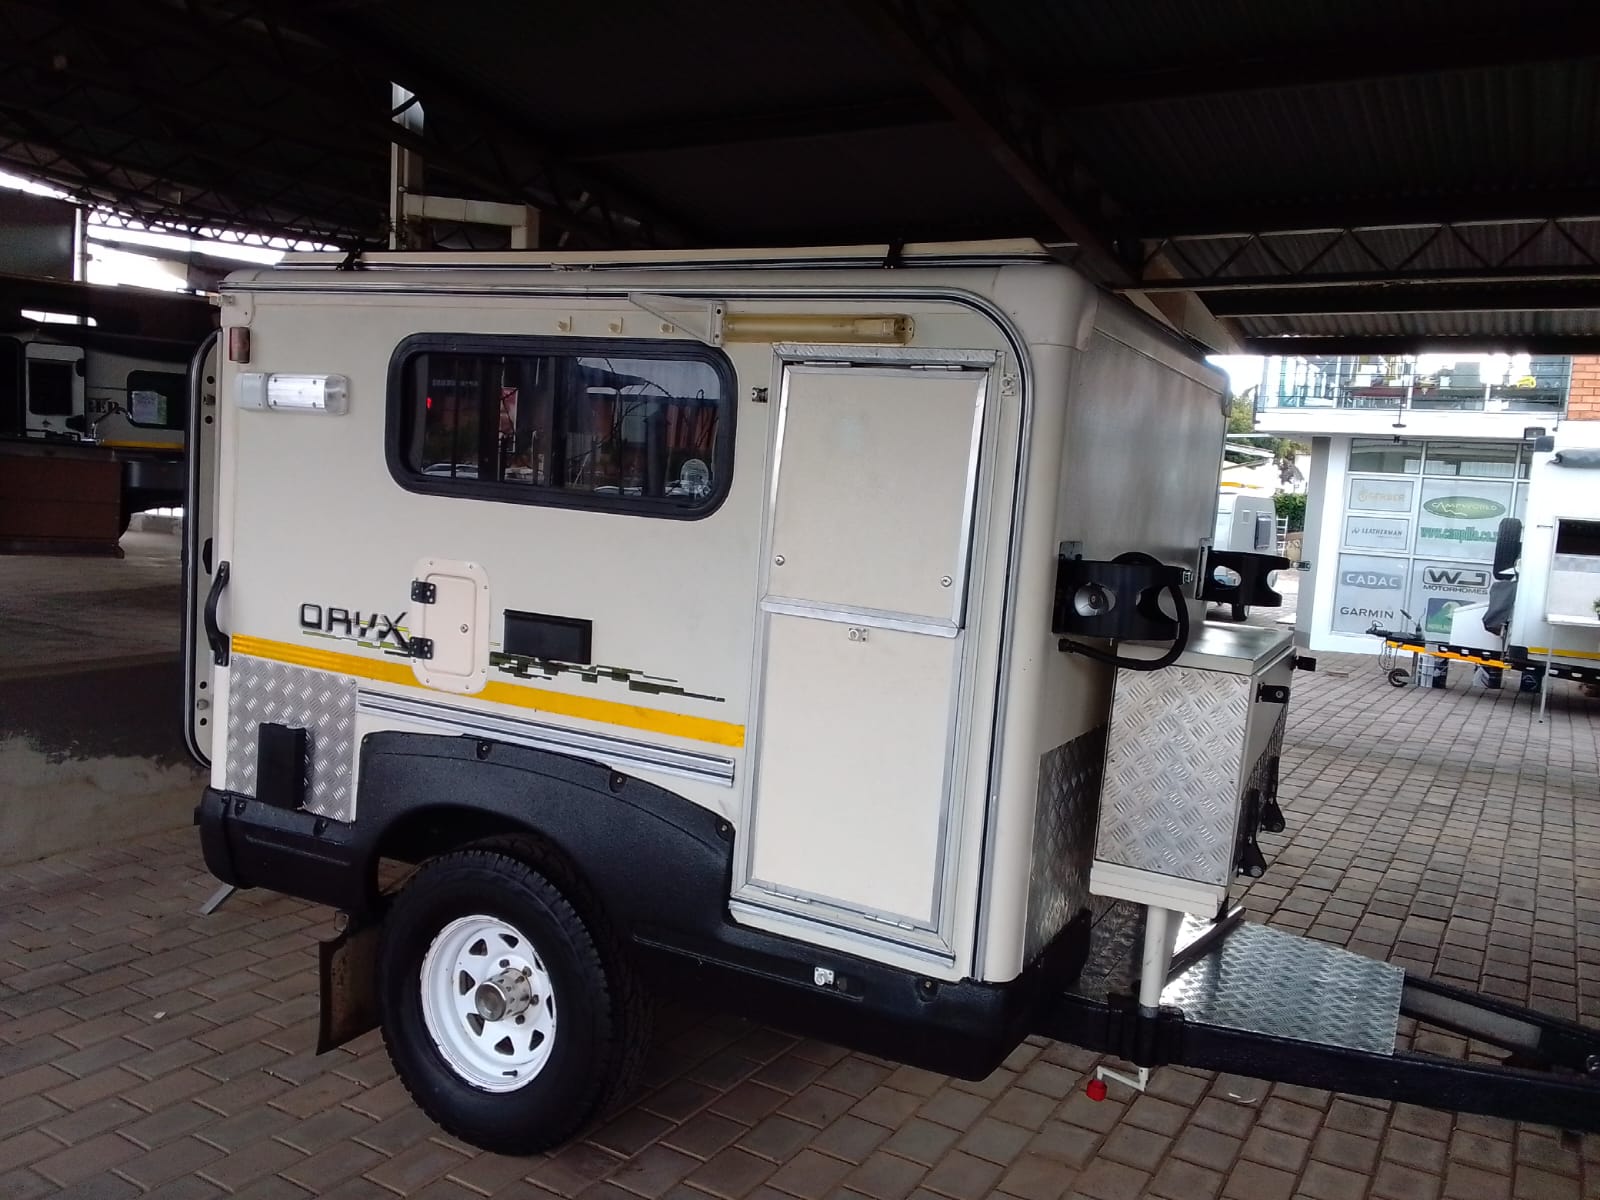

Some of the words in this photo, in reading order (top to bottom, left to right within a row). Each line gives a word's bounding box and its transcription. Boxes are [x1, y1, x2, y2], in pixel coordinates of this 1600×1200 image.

[1361, 527, 1403, 537] LEATHERMAN
[1346, 573, 1399, 587] CADAC
[1423, 585, 1488, 595] MOTORHOMES
[1340, 606, 1394, 619] GARMIN
[301, 603, 411, 650] ORYX
